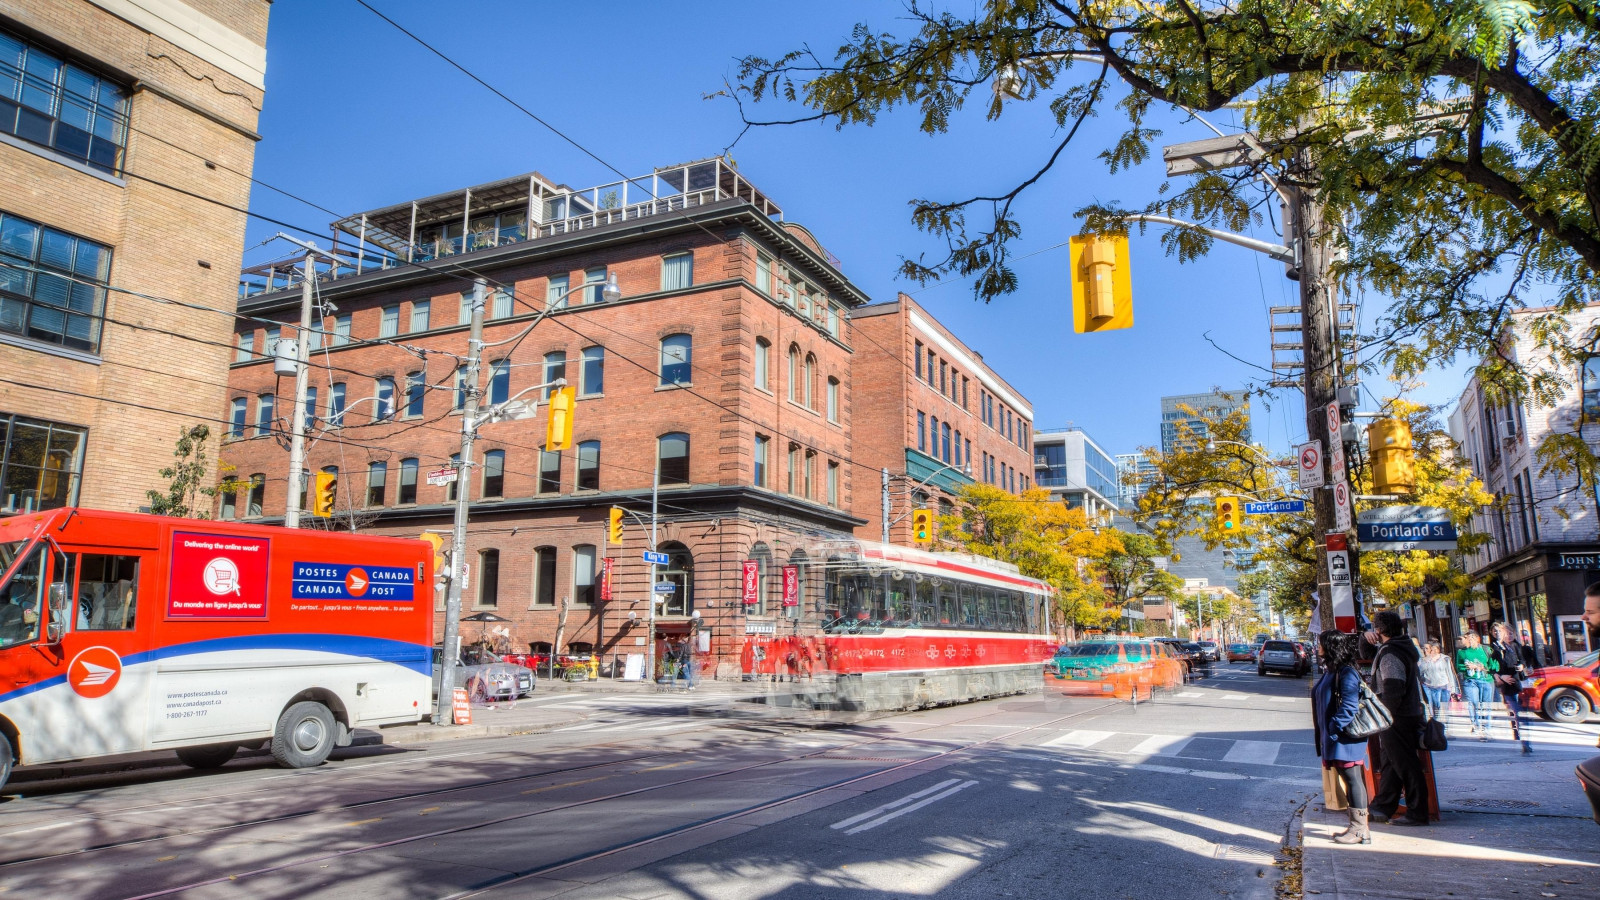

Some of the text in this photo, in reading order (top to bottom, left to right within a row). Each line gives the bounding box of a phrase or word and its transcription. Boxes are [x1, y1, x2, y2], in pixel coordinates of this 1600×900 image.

[1250, 502, 1291, 511] Portland
[1371, 523, 1444, 538] Portland St
[184, 540, 213, 550] Delivering
[1560, 555, 1595, 567] JOHN
[299, 567, 410, 580] POSTES CANADA
[298, 585, 395, 596] CANADA POST
[167, 690, 228, 699] www.postescanada.ca
[166, 700, 222, 708] www.canadapost.ca
[166, 710, 208, 719] 1-800-267-1177
